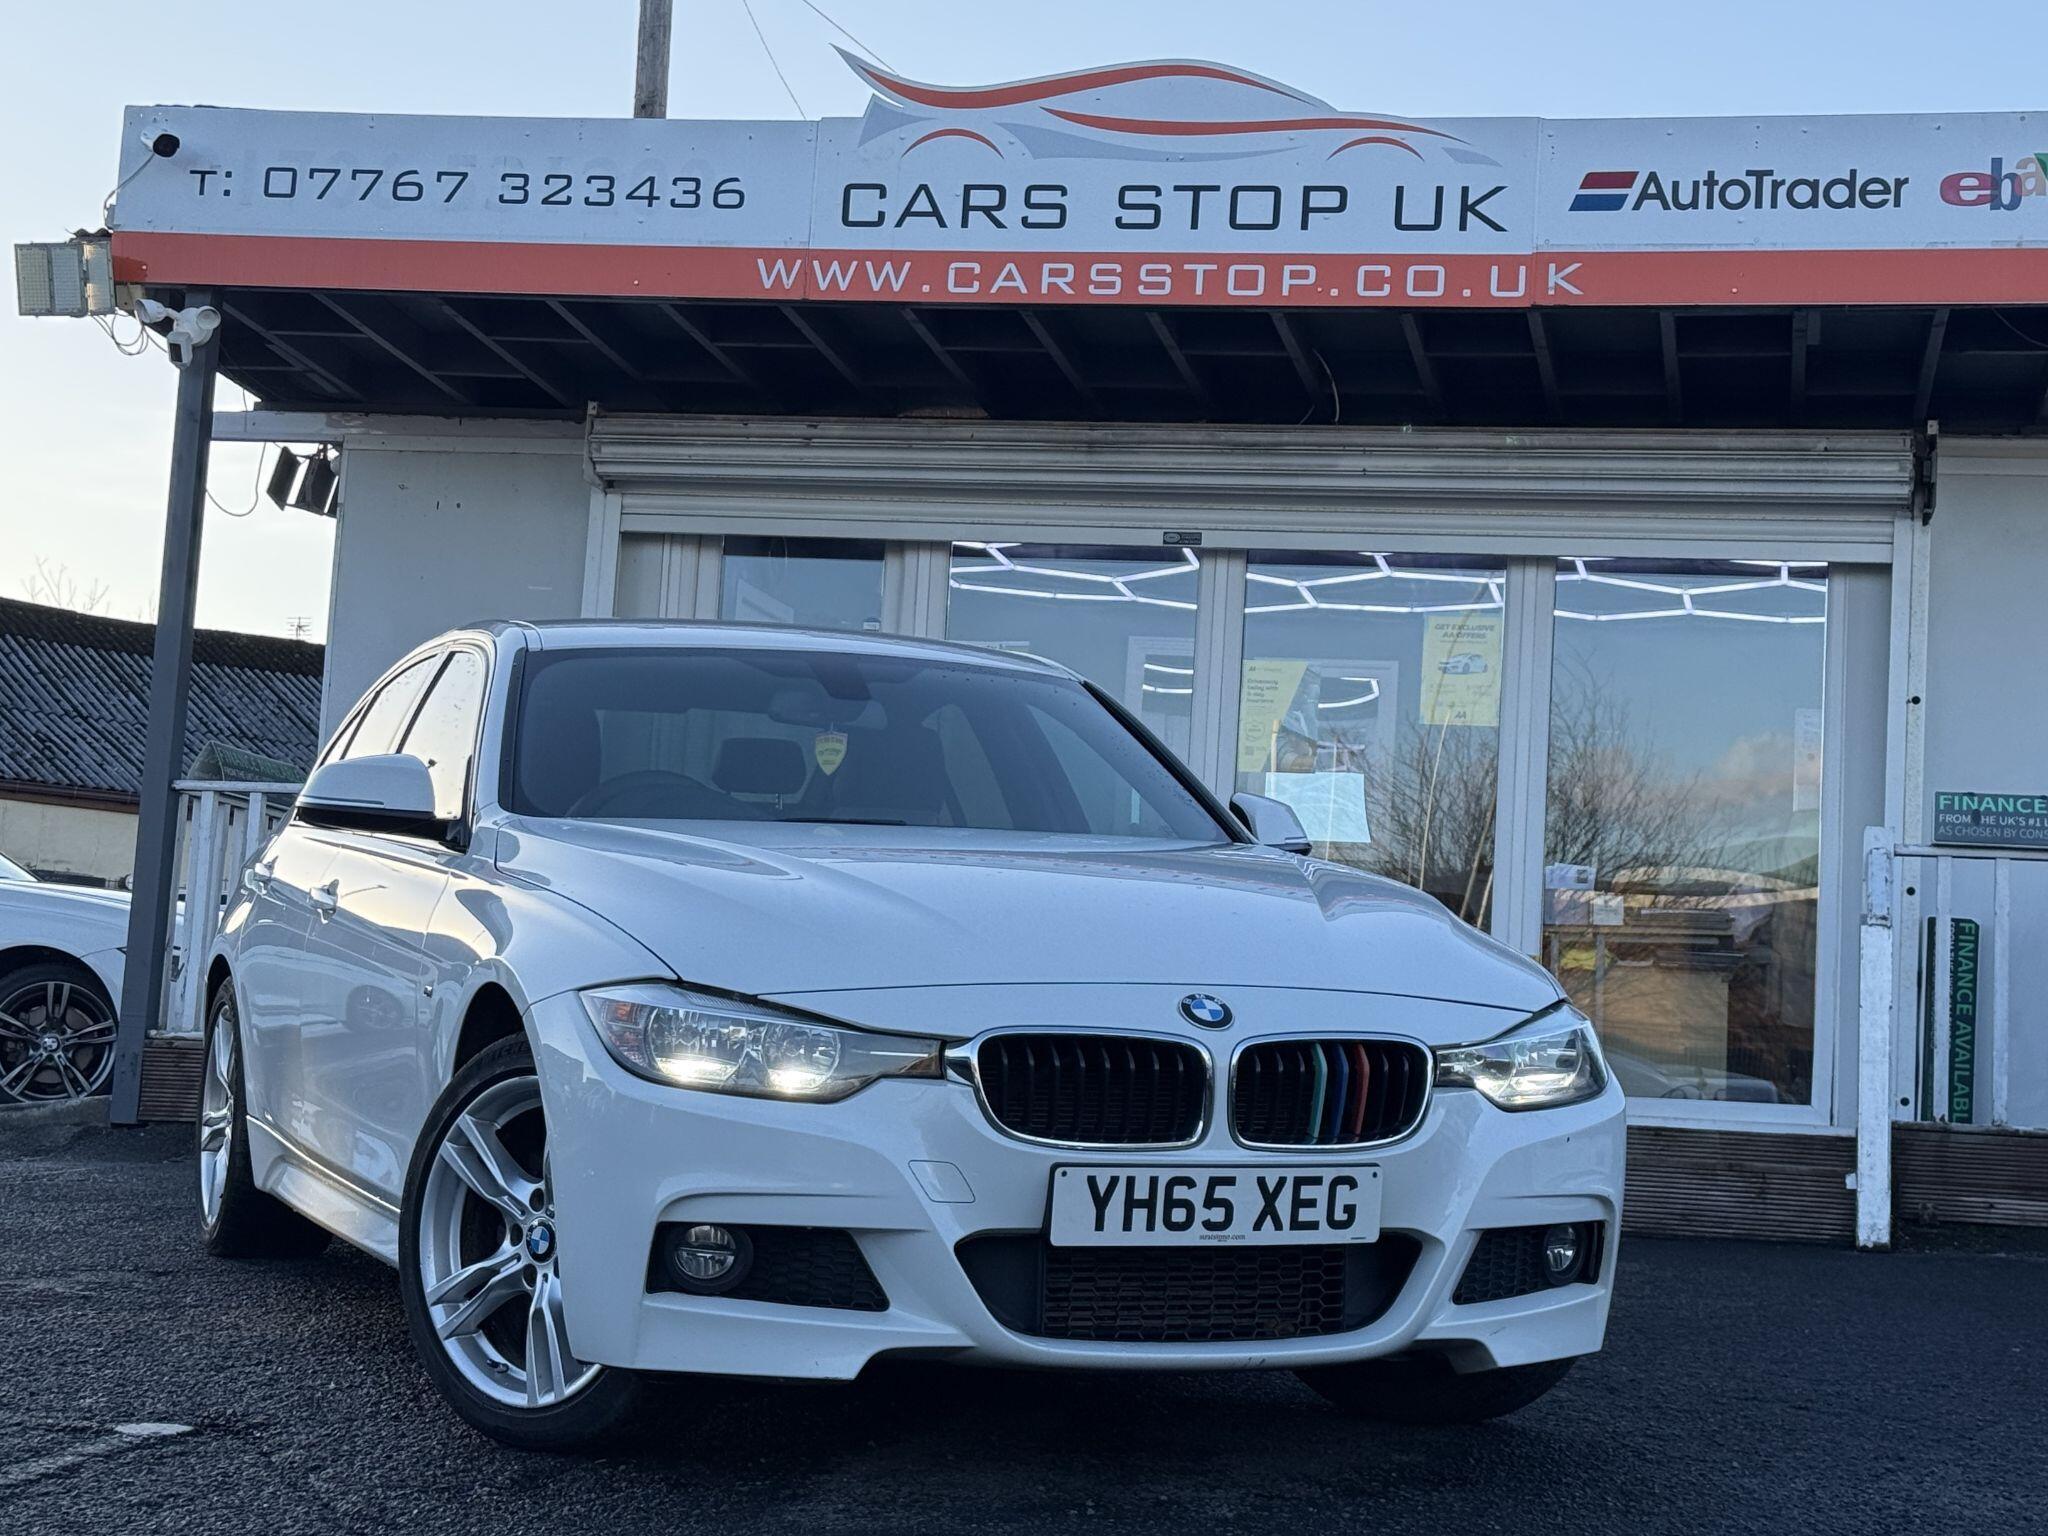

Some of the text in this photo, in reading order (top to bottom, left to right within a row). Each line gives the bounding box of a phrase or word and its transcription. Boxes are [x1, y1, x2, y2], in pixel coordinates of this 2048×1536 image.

[190, 167, 745, 210] T: 07767 323436
[842, 184, 1508, 232] CARS STOP UK
[1631, 168, 1910, 212] AutoTrader
[757, 257, 1584, 299] WWW.CARSSTOP.CO.UK
[1939, 794, 2048, 814] FINANCE
[1939, 813, 1972, 825] FROM
[1999, 816, 2026, 827] UK'S
[1938, 825, 1953, 836] AS
[1955, 826, 2001, 838] CHOSEN
[2004, 828, 2018, 839] BY
[1955, 922, 1976, 1016] FINANCE
[1086, 1174, 1359, 1233] YH65 XEG
